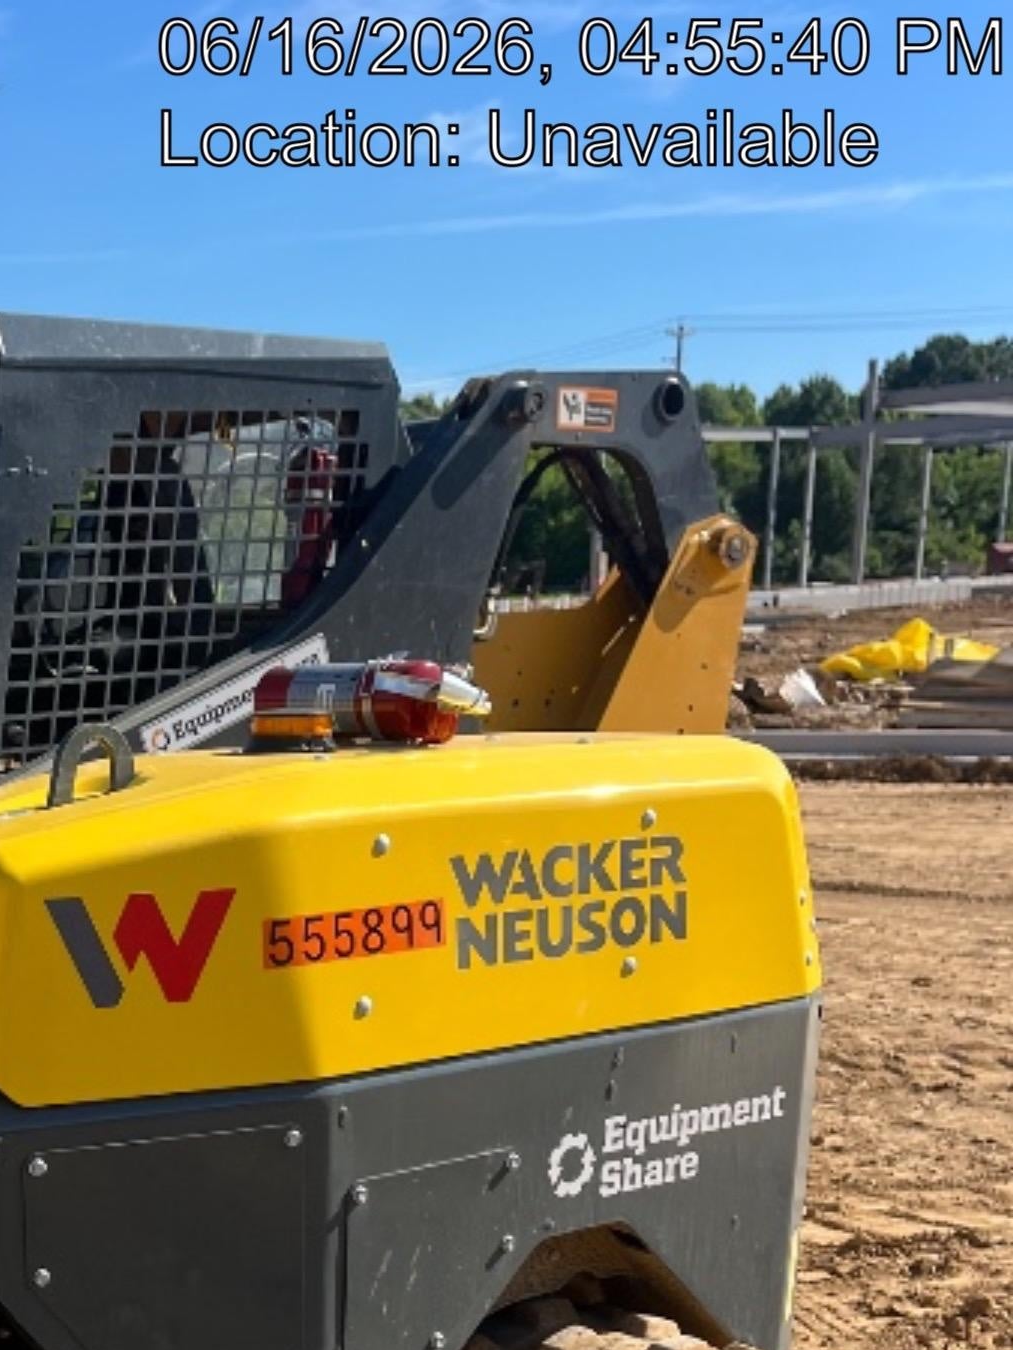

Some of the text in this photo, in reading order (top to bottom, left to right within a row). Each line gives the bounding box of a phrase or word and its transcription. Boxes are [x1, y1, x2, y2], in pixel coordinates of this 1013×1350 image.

[449, 836, 687, 908] WACKER
[267, 900, 443, 967] 555899
[455, 891, 688, 970] NEUSON
[601, 1085, 786, 1156] Equipment
[599, 1150, 700, 1197] Share
